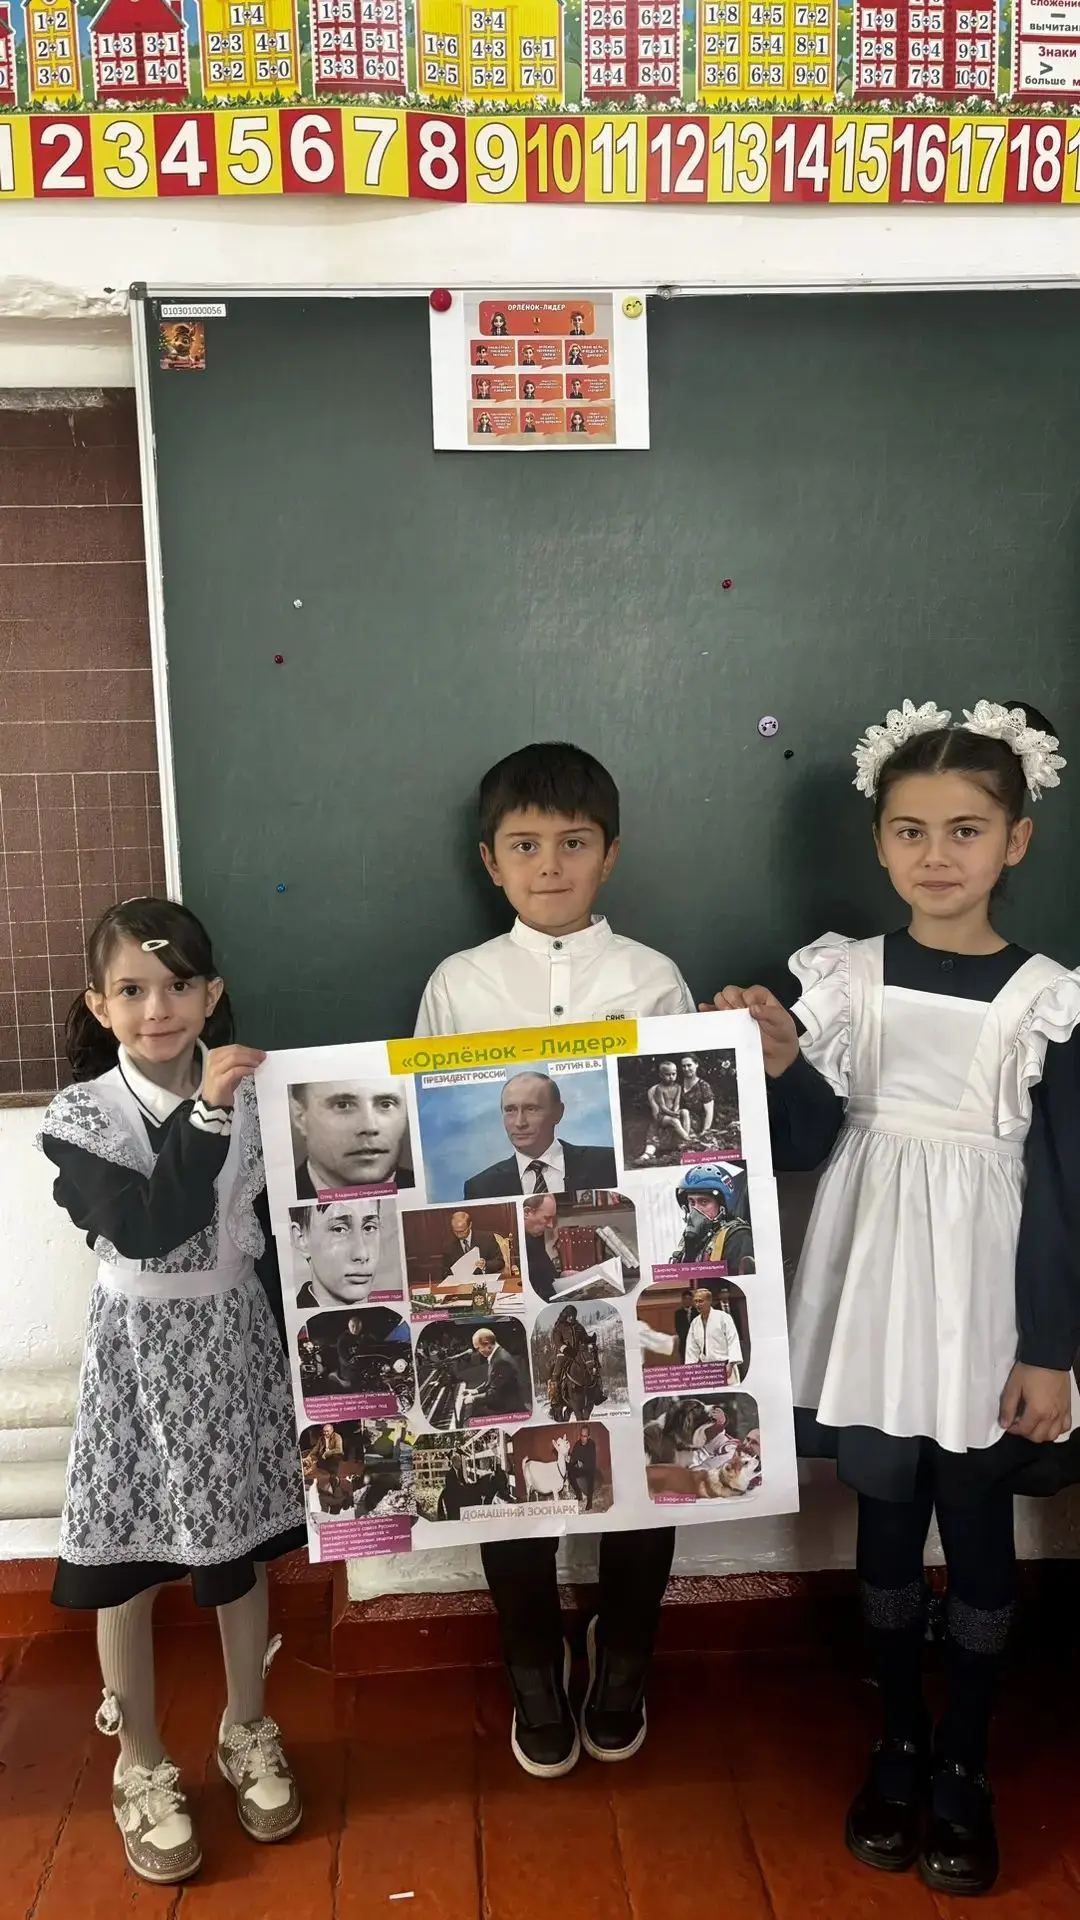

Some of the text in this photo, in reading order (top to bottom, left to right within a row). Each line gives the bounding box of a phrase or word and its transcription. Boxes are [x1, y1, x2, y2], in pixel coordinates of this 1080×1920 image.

[1038, 46, 1077, 57] Знаки
[1025, 75, 1066, 86] больше
[40, 123, 87, 190] 2
[103, 120, 149, 190] 3
[160, 119, 208, 187] 4
[227, 116, 274, 185] 5
[290, 114, 335, 183] 6
[353, 115, 399, 186] 7
[418, 120, 460, 191] 8
[474, 121, 520, 194] 9
[527, 122, 583, 194] 10
[591, 122, 638, 194] 11
[650, 123, 706, 194] 12
[712, 121, 769, 194] 13
[774, 123, 830, 193] 14
[834, 122, 889, 194] 15
[893, 123, 947, 194] 16
[950, 122, 1006, 194] 17
[1010, 124, 1062, 193] 18
[402, 1046, 516, 1070] «Орлёнок
[540, 1036, 627, 1056] Лидер»
[555, 1062, 583, 1072] ПУТИН
[423, 1070, 506, 1085] ПРЕЗИДЕНТ РОССИИ
[462, 1505, 576, 1521] ДОМАШНИЙ ЗООПАРК
